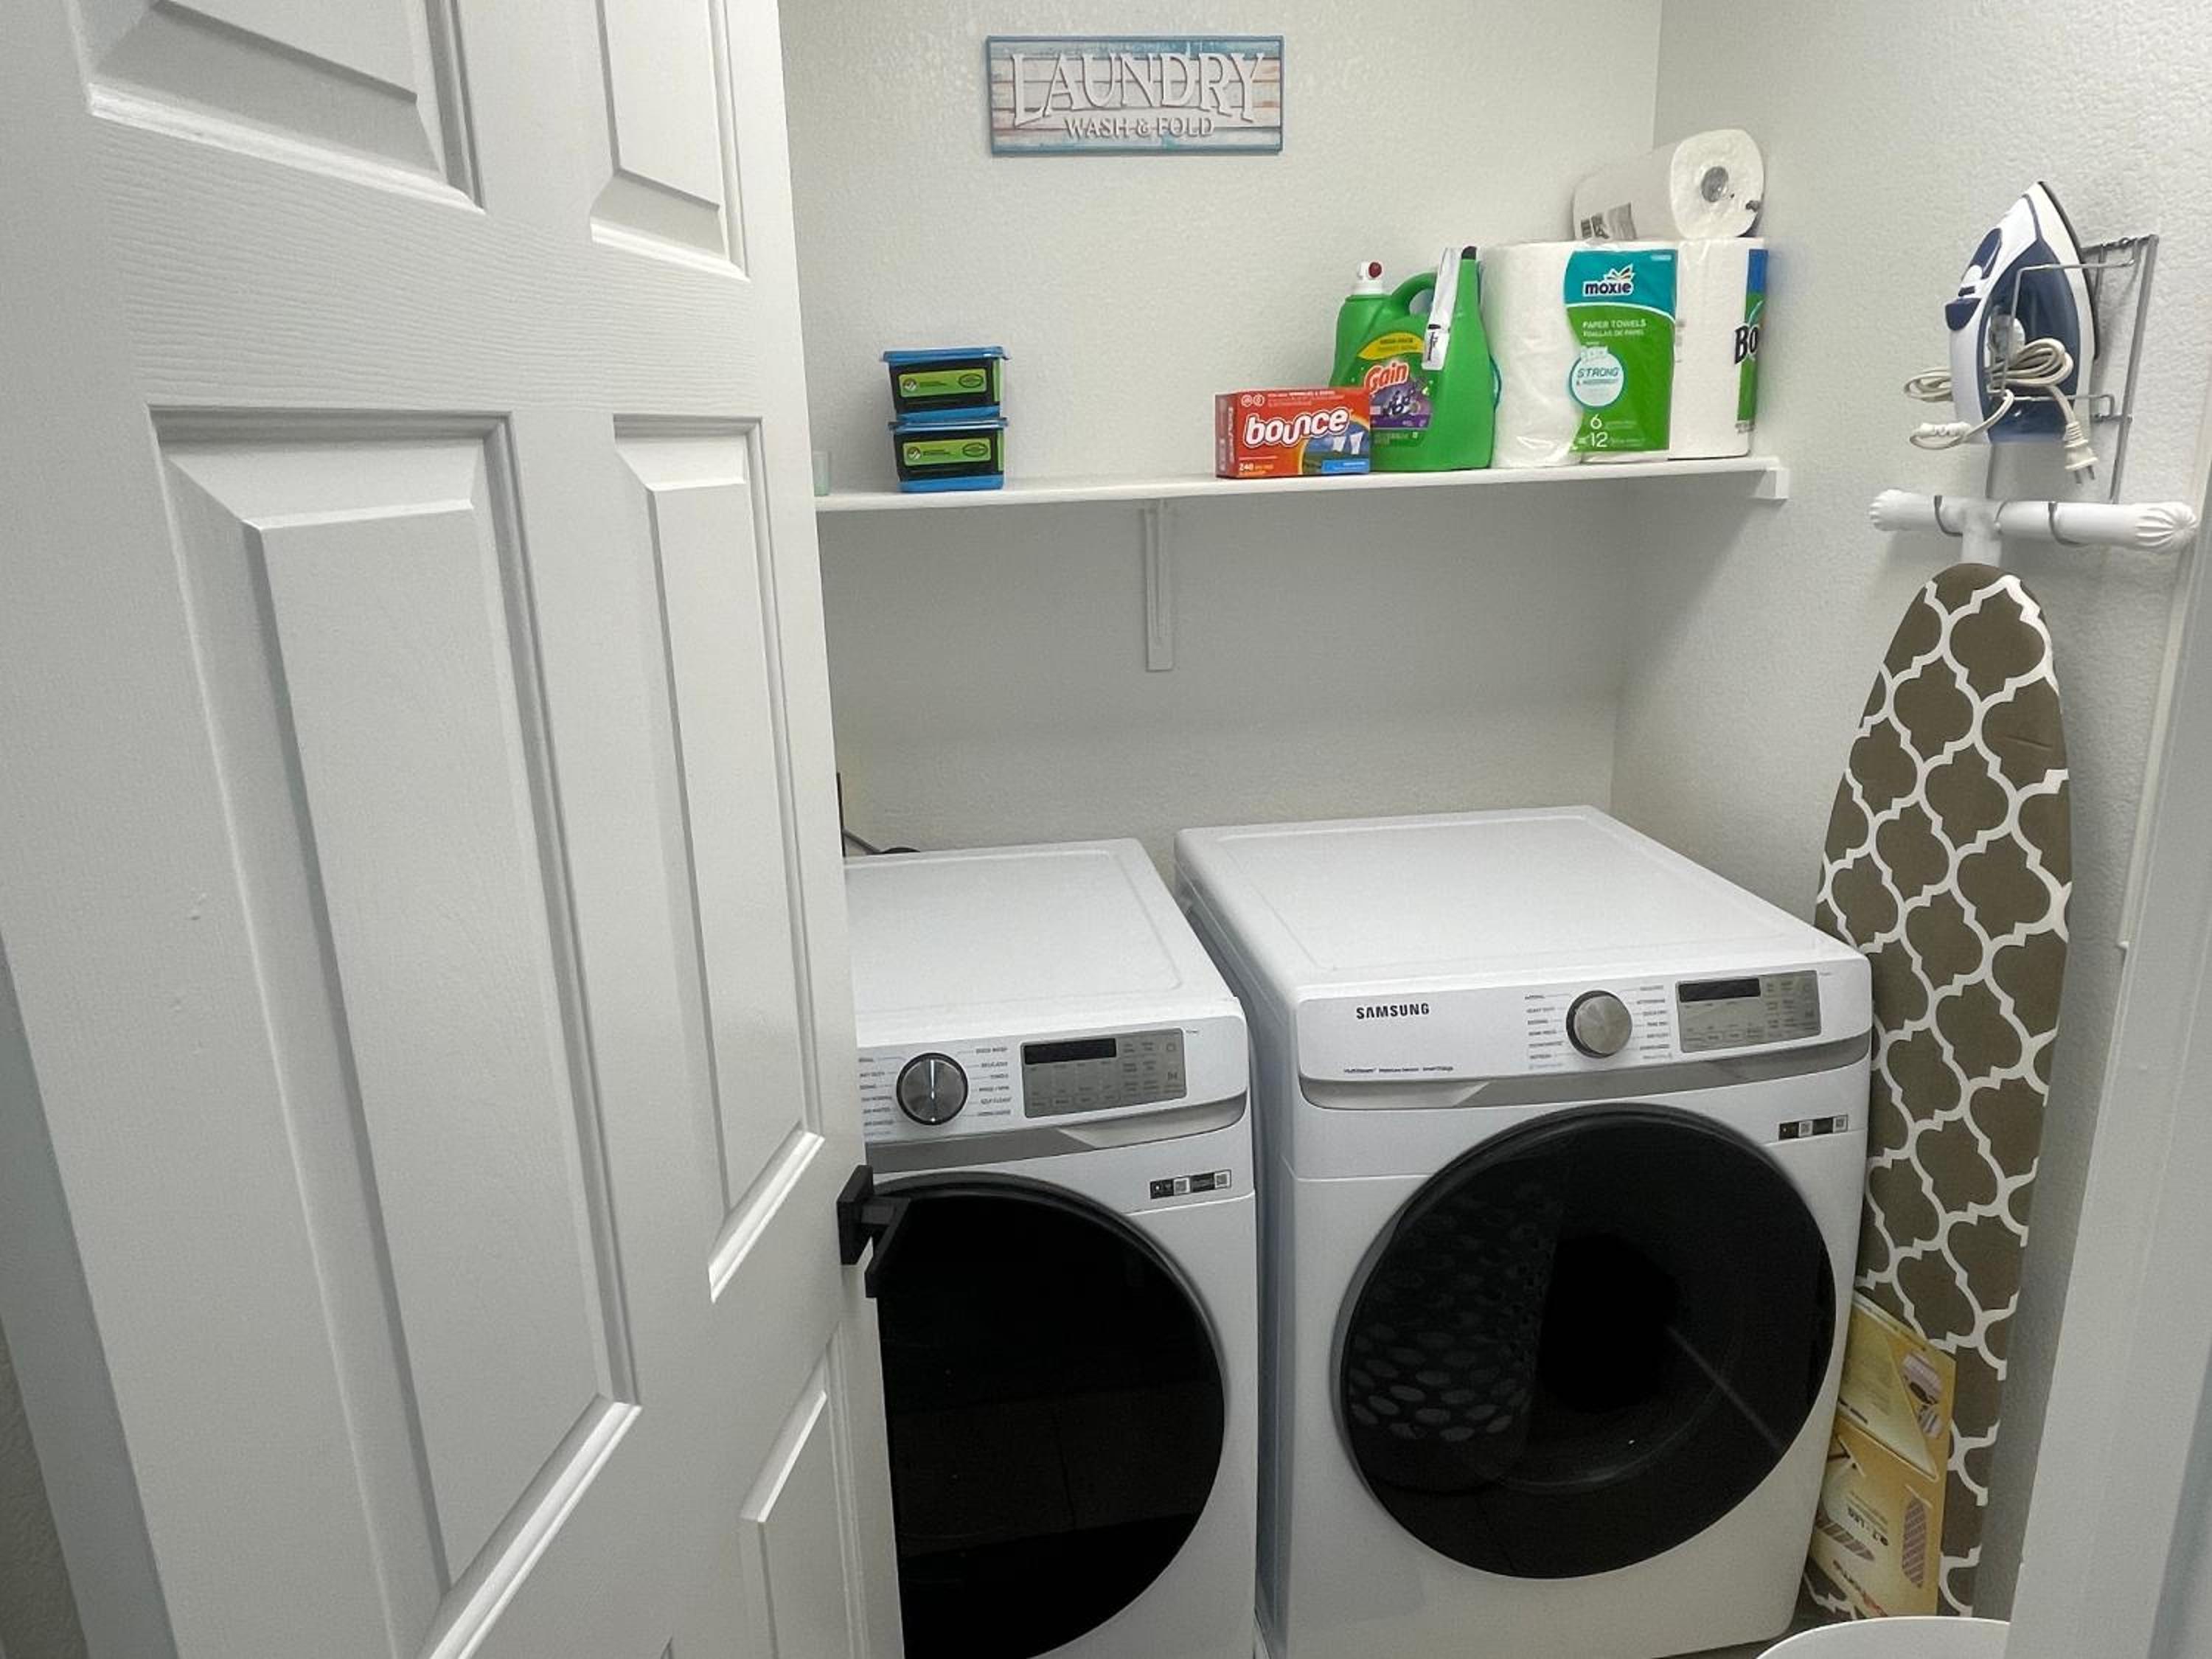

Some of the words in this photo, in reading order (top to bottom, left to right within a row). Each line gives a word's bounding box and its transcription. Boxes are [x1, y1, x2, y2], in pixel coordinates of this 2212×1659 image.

[1010, 52, 1265, 127] LAUNDRY
[1065, 116, 1130, 139] WASH
[1135, 117, 1150, 138] &
[1157, 116, 1215, 138] FOLD
[1585, 282, 1632, 295] moxie
[1582, 319, 1609, 329] PAPER
[1610, 318, 1646, 329] TOWELS
[1365, 361, 1409, 392] Gain
[1577, 366, 1621, 378] STRONG
[1244, 406, 1350, 448] bounce
[1590, 414, 1602, 430] 6
[1591, 431, 1608, 448] 12
[1356, 1003, 1430, 1020] SAMSUNG
